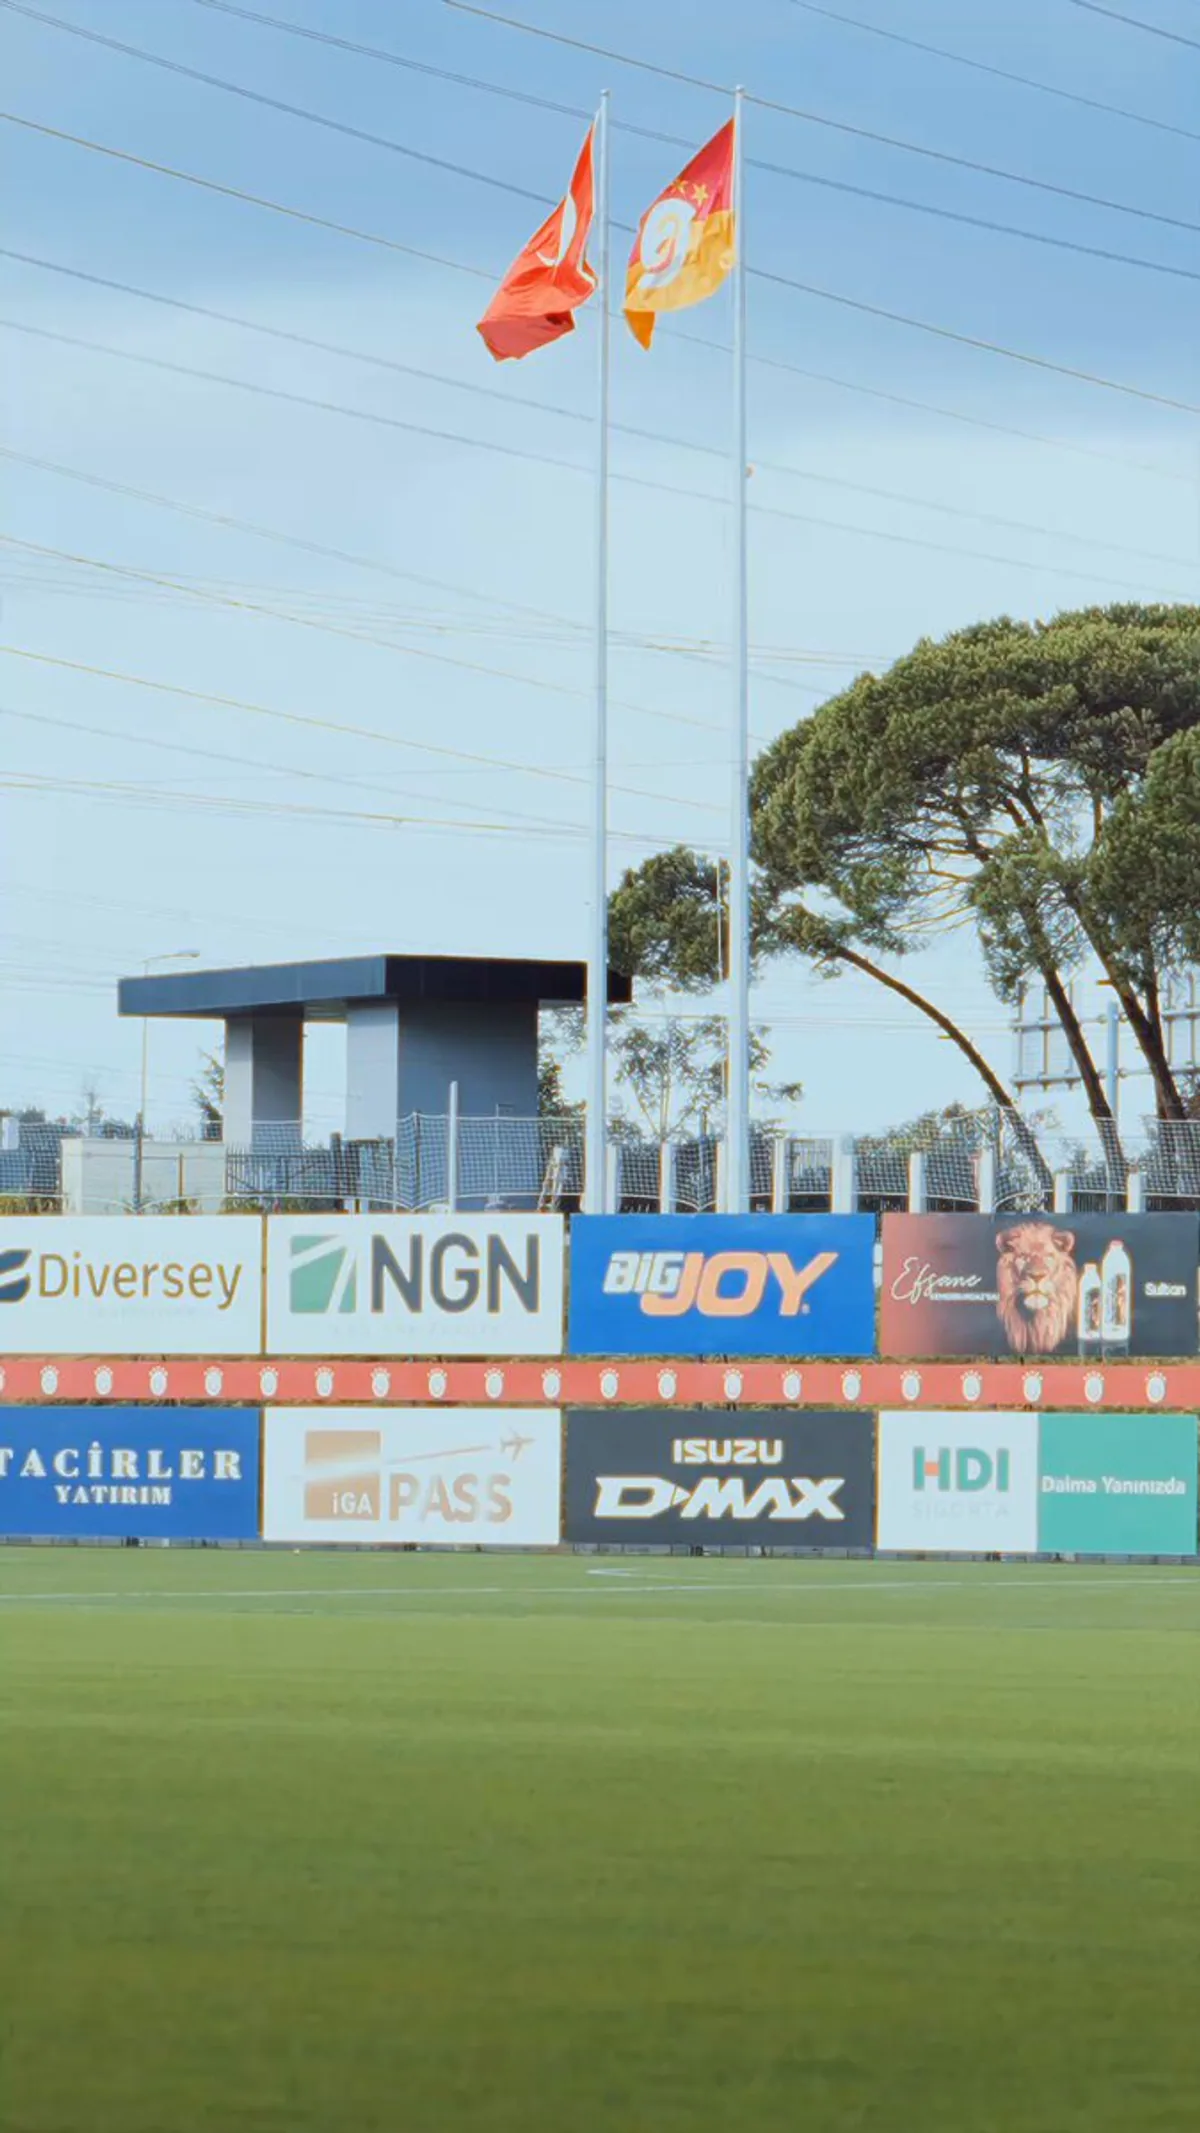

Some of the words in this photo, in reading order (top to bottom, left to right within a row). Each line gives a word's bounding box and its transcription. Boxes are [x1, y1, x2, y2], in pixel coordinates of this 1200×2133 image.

[38, 1252, 243, 1310] Diversey
[370, 1233, 539, 1313] NGN
[673, 1438, 783, 1465] ISUZU
[913, 1446, 1010, 1493] HDI
[54, 1485, 171, 1505] YATIRIM
[390, 1472, 512, 1523] PASS
